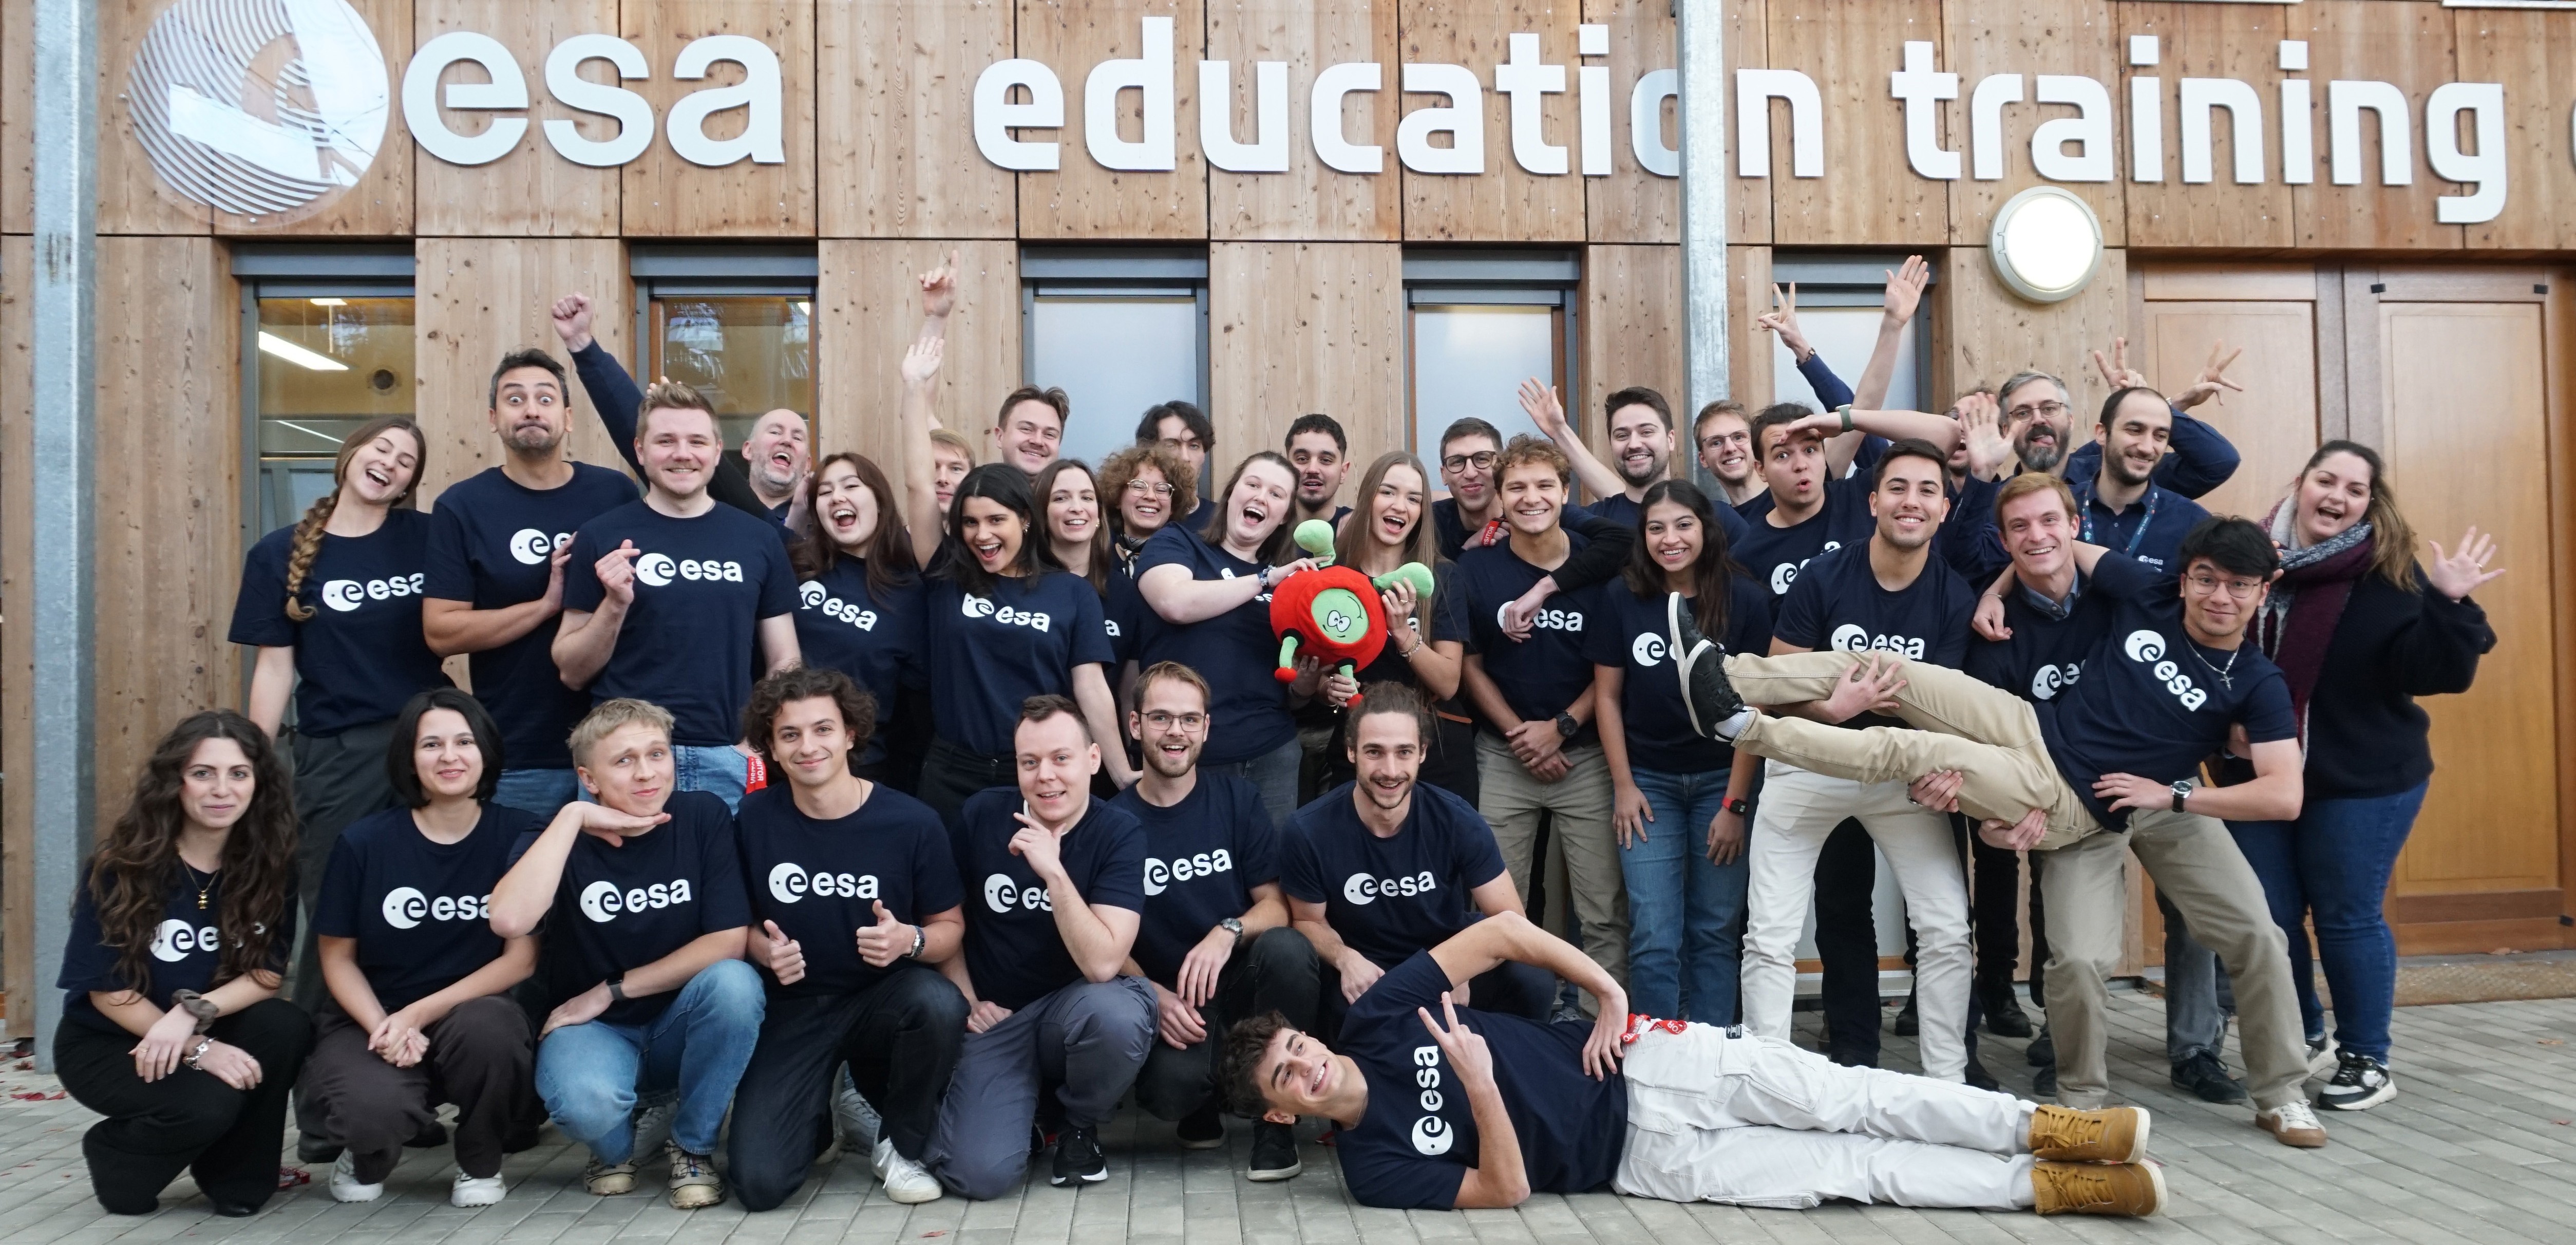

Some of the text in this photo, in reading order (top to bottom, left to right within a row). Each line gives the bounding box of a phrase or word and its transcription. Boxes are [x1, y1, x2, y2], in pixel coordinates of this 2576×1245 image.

[402, 31, 786, 166] esa
[1890, 34, 2508, 224] training
[1483, 526, 1495, 545] ISITOR
[679, 559, 743, 582] esa
[823, 598, 877, 632] esa
[995, 606, 1050, 633] esa
[1533, 608, 1583, 631] esa
[1871, 634, 1925, 659] esa
[2154, 661, 2207, 712] esa
[755, 759, 764, 781] ISITOR
[1172, 848, 1232, 881] esa
[626, 879, 691, 913] esa
[812, 872, 878, 899] esa
[1380, 871, 1436, 896] esa
[1022, 887, 1053, 911] es
[1414, 1045, 1443, 1111] esa
